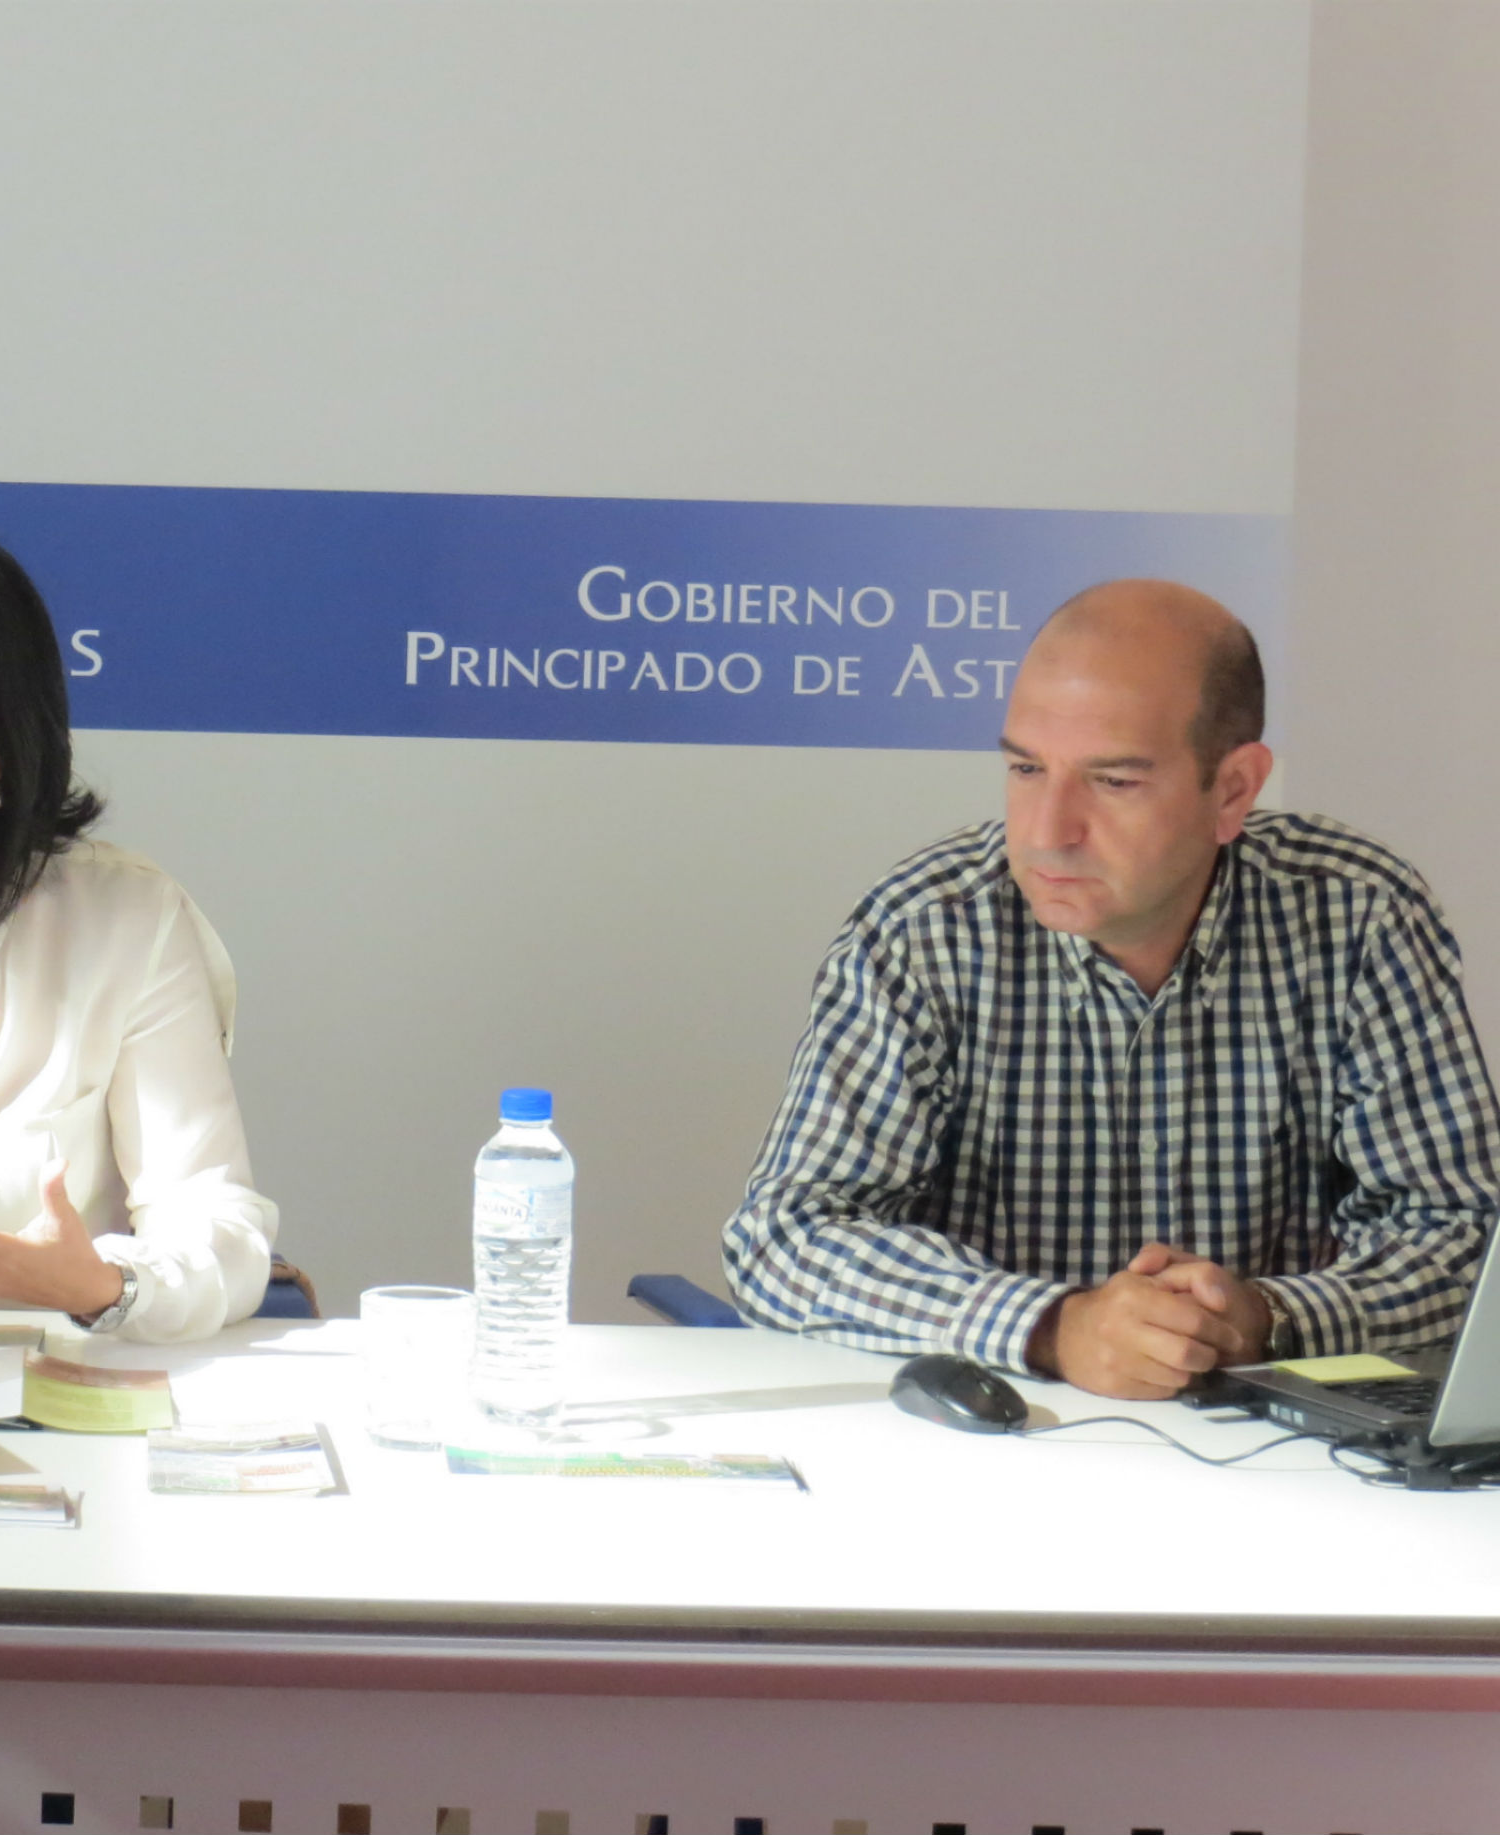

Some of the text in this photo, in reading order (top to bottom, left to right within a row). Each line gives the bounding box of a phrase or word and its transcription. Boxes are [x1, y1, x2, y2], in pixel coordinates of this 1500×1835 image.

[577, 564, 1021, 630] GOBIERNO DEL
[405, 630, 763, 695] PRINCIPADO
[793, 654, 861, 697] DE
